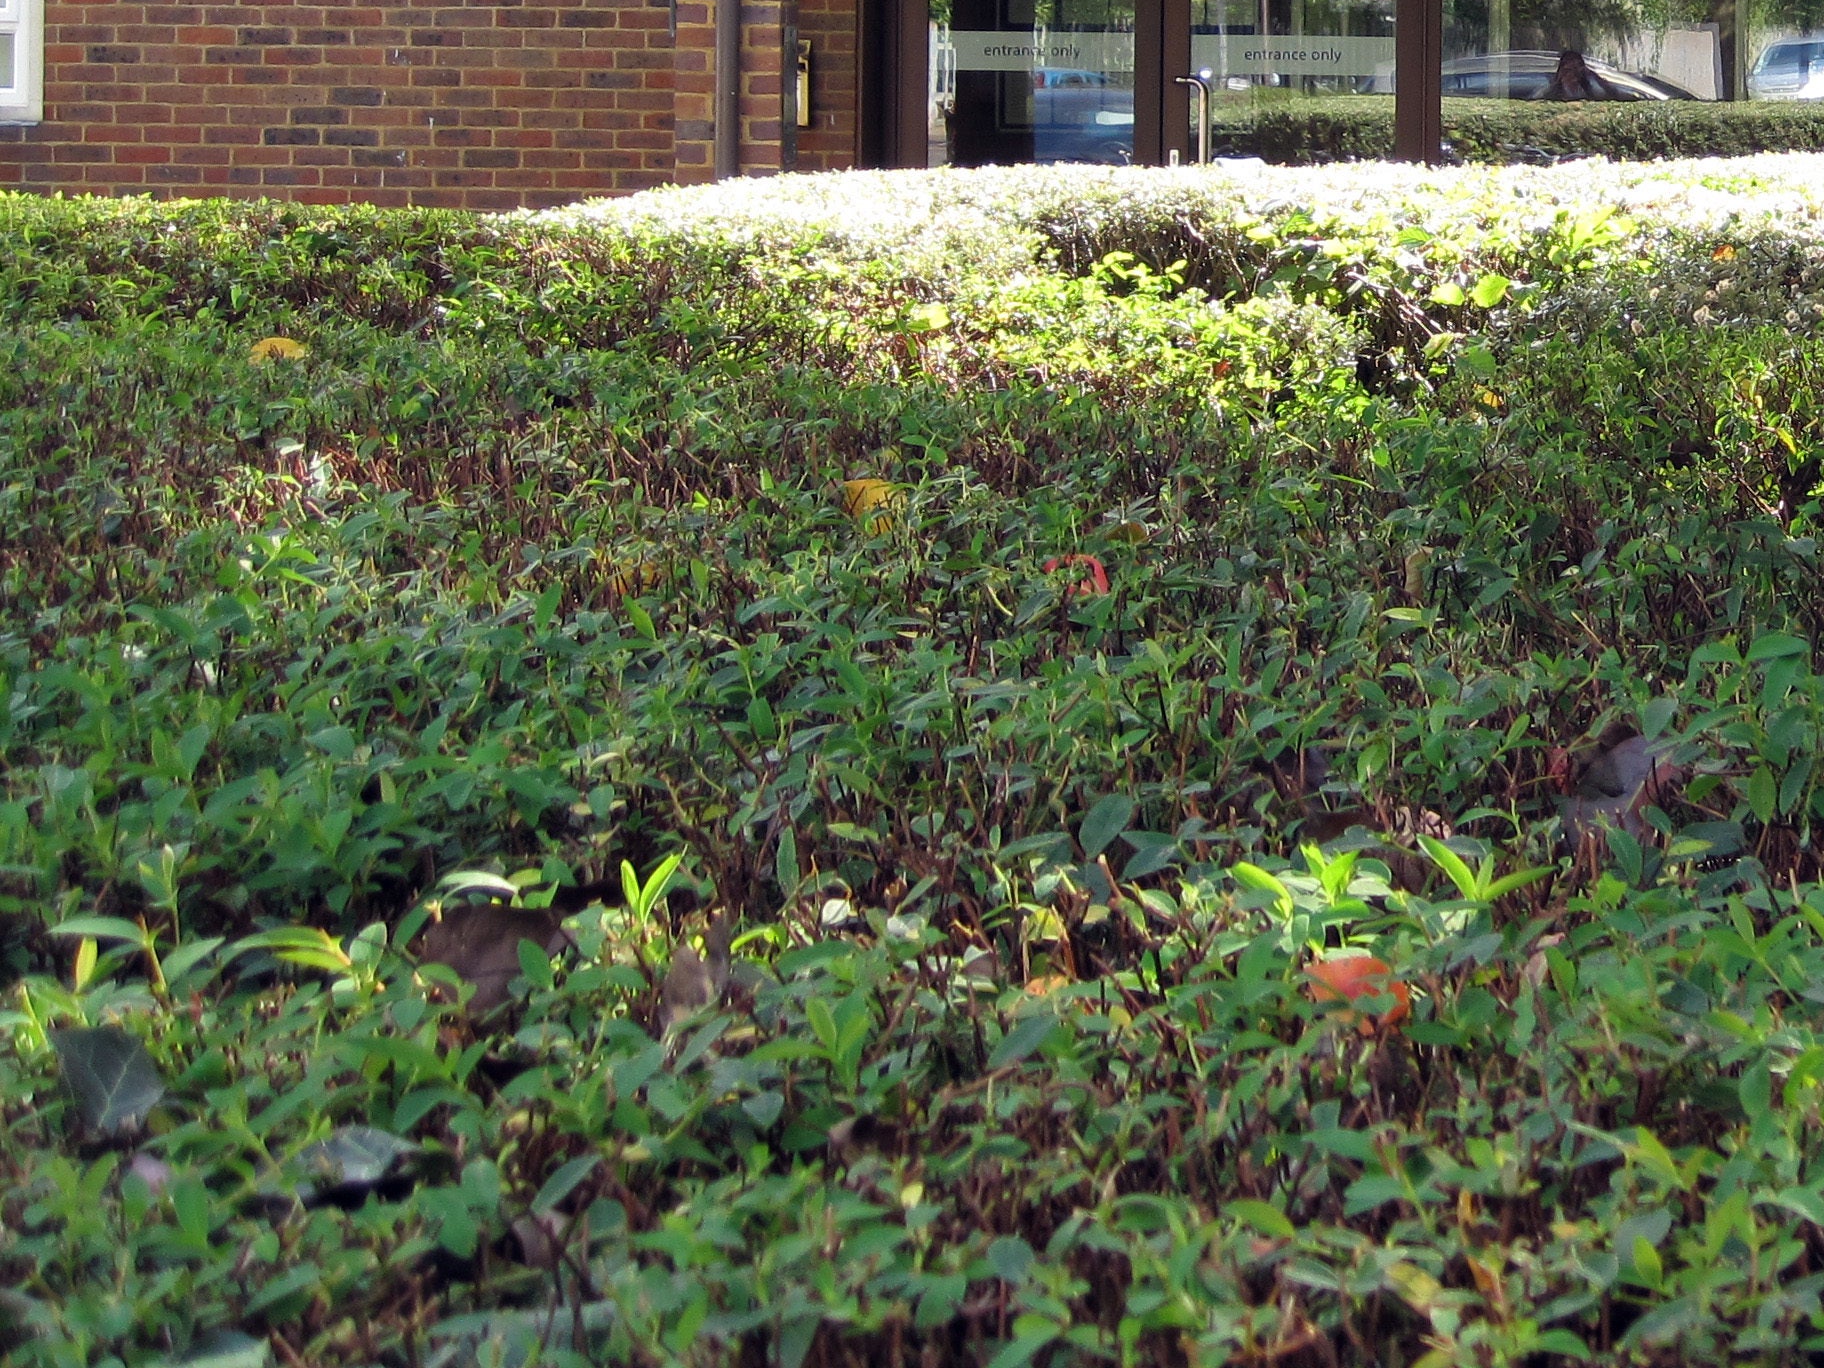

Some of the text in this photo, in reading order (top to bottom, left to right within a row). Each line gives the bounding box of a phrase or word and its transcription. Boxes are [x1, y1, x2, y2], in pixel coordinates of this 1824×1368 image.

[983, 43, 1080, 60] entrance only
[1244, 47, 1342, 64] entrance only
